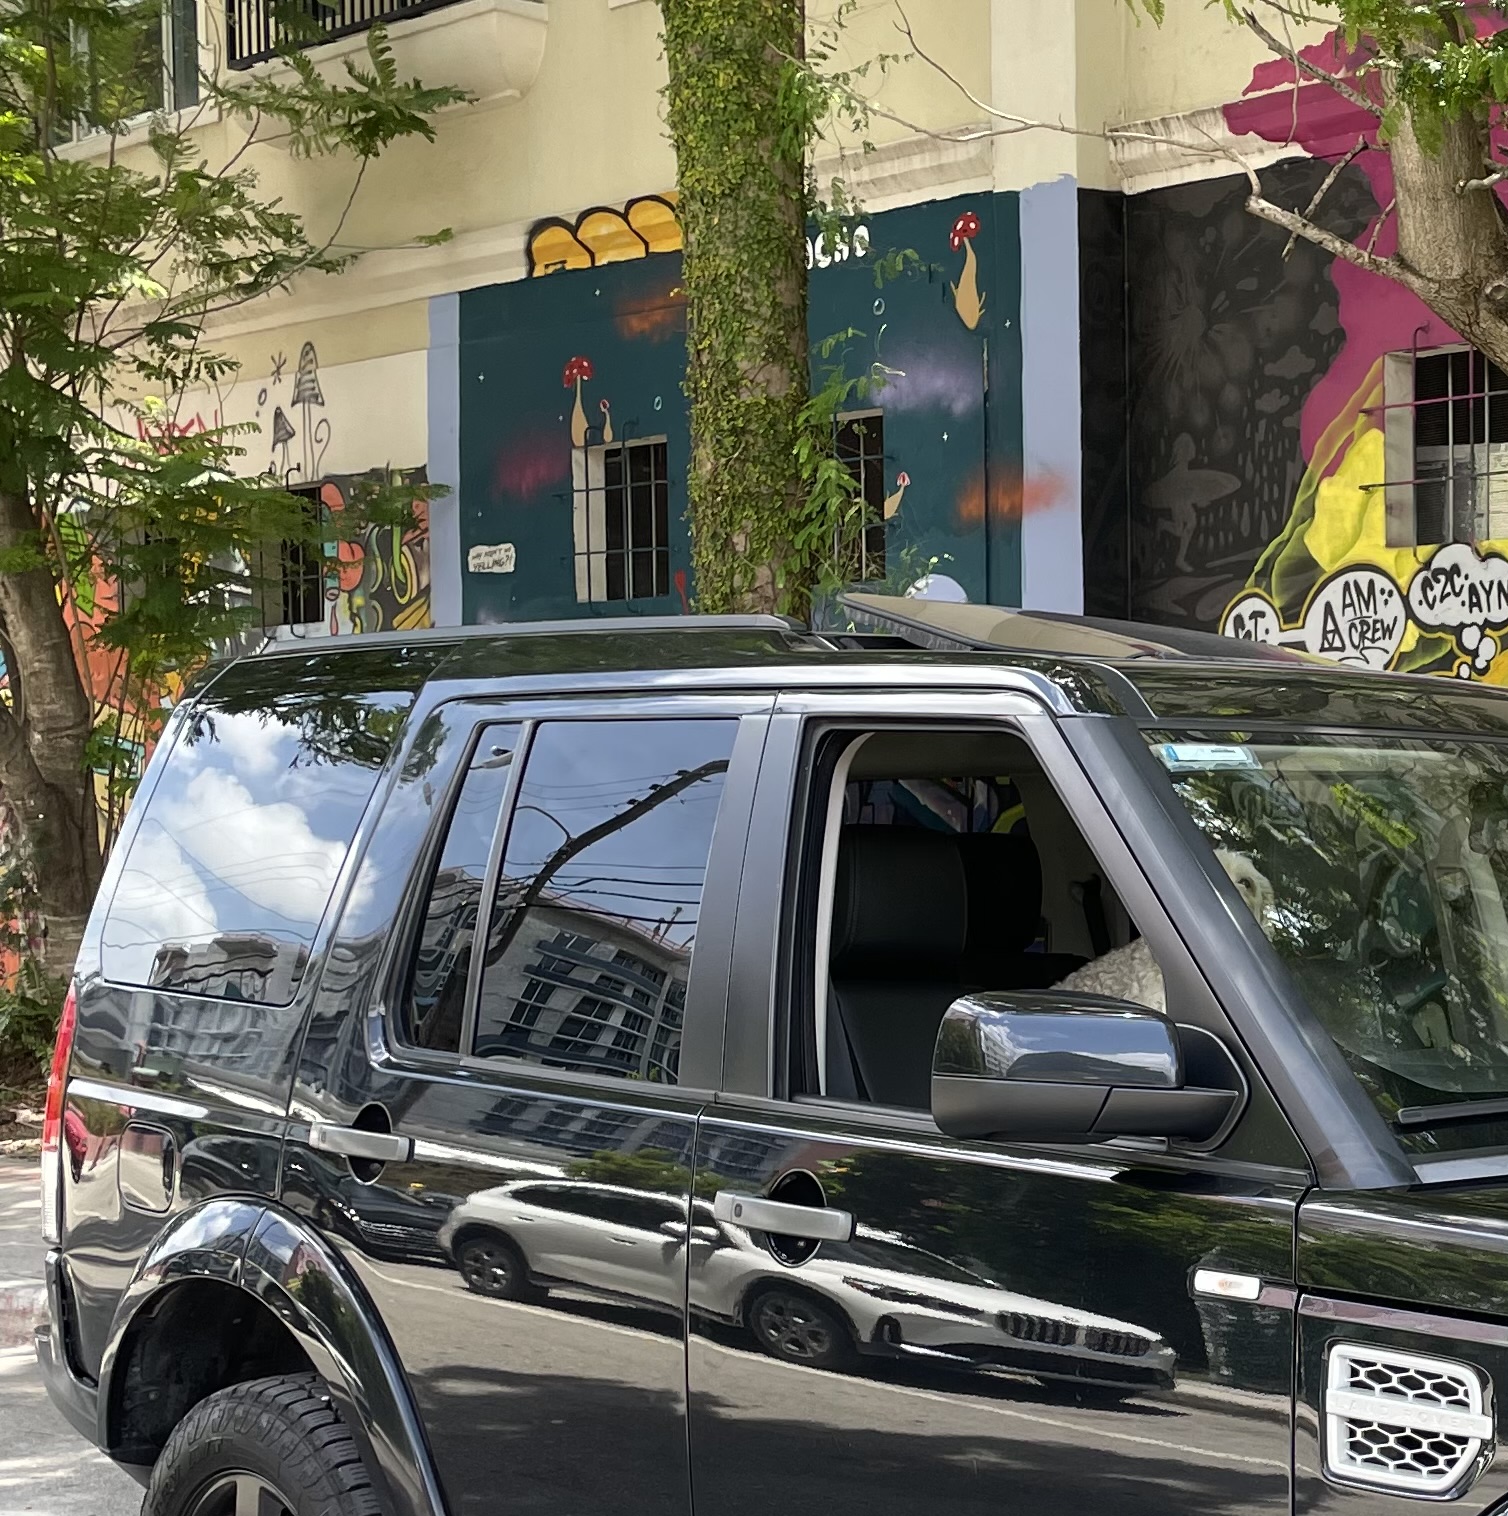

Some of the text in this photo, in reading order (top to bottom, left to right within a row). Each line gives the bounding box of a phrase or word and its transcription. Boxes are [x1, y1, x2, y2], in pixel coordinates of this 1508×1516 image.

[1342, 578, 1377, 617] AM
[1348, 616, 1398, 652] CREW
[1335, 1398, 1477, 1432] LAND ROVER
